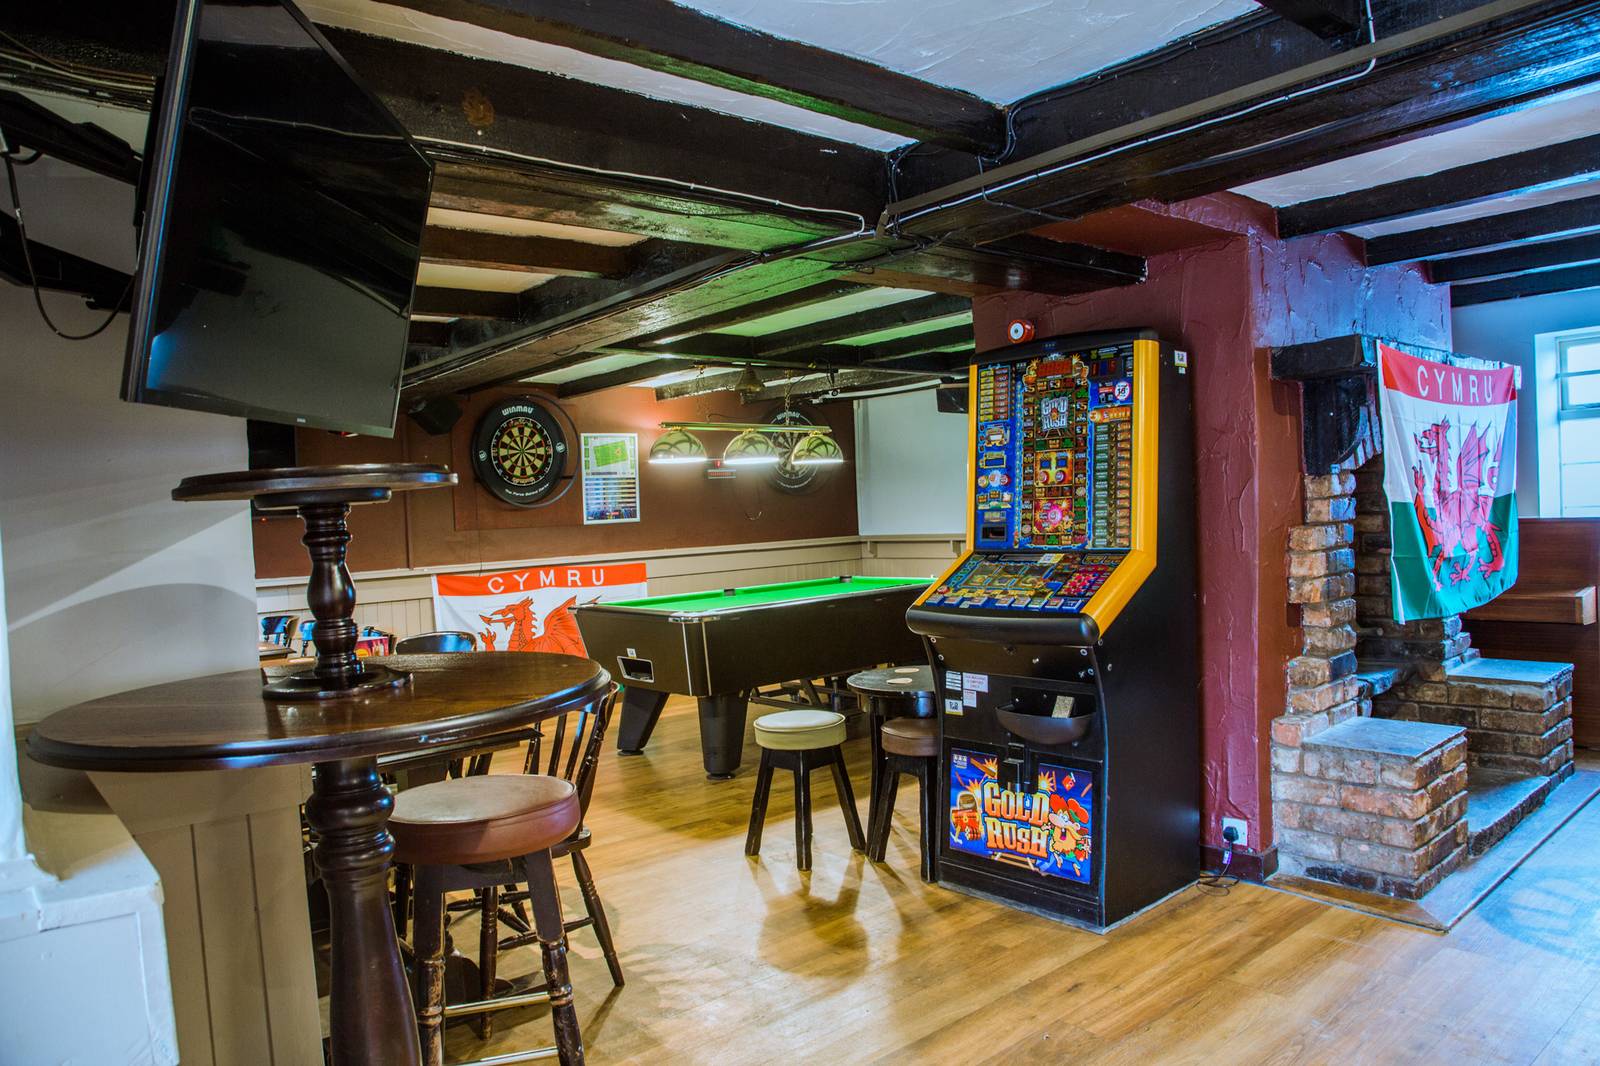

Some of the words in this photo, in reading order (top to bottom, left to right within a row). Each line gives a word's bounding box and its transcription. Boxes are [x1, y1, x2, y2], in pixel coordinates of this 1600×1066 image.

[1417, 365, 1494, 403] CYMRU
[502, 405, 535, 416] WINMAU
[487, 568, 605, 593] CYMRU
[983, 781, 1050, 827] GOLD
[984, 816, 1049, 858] RUSH
